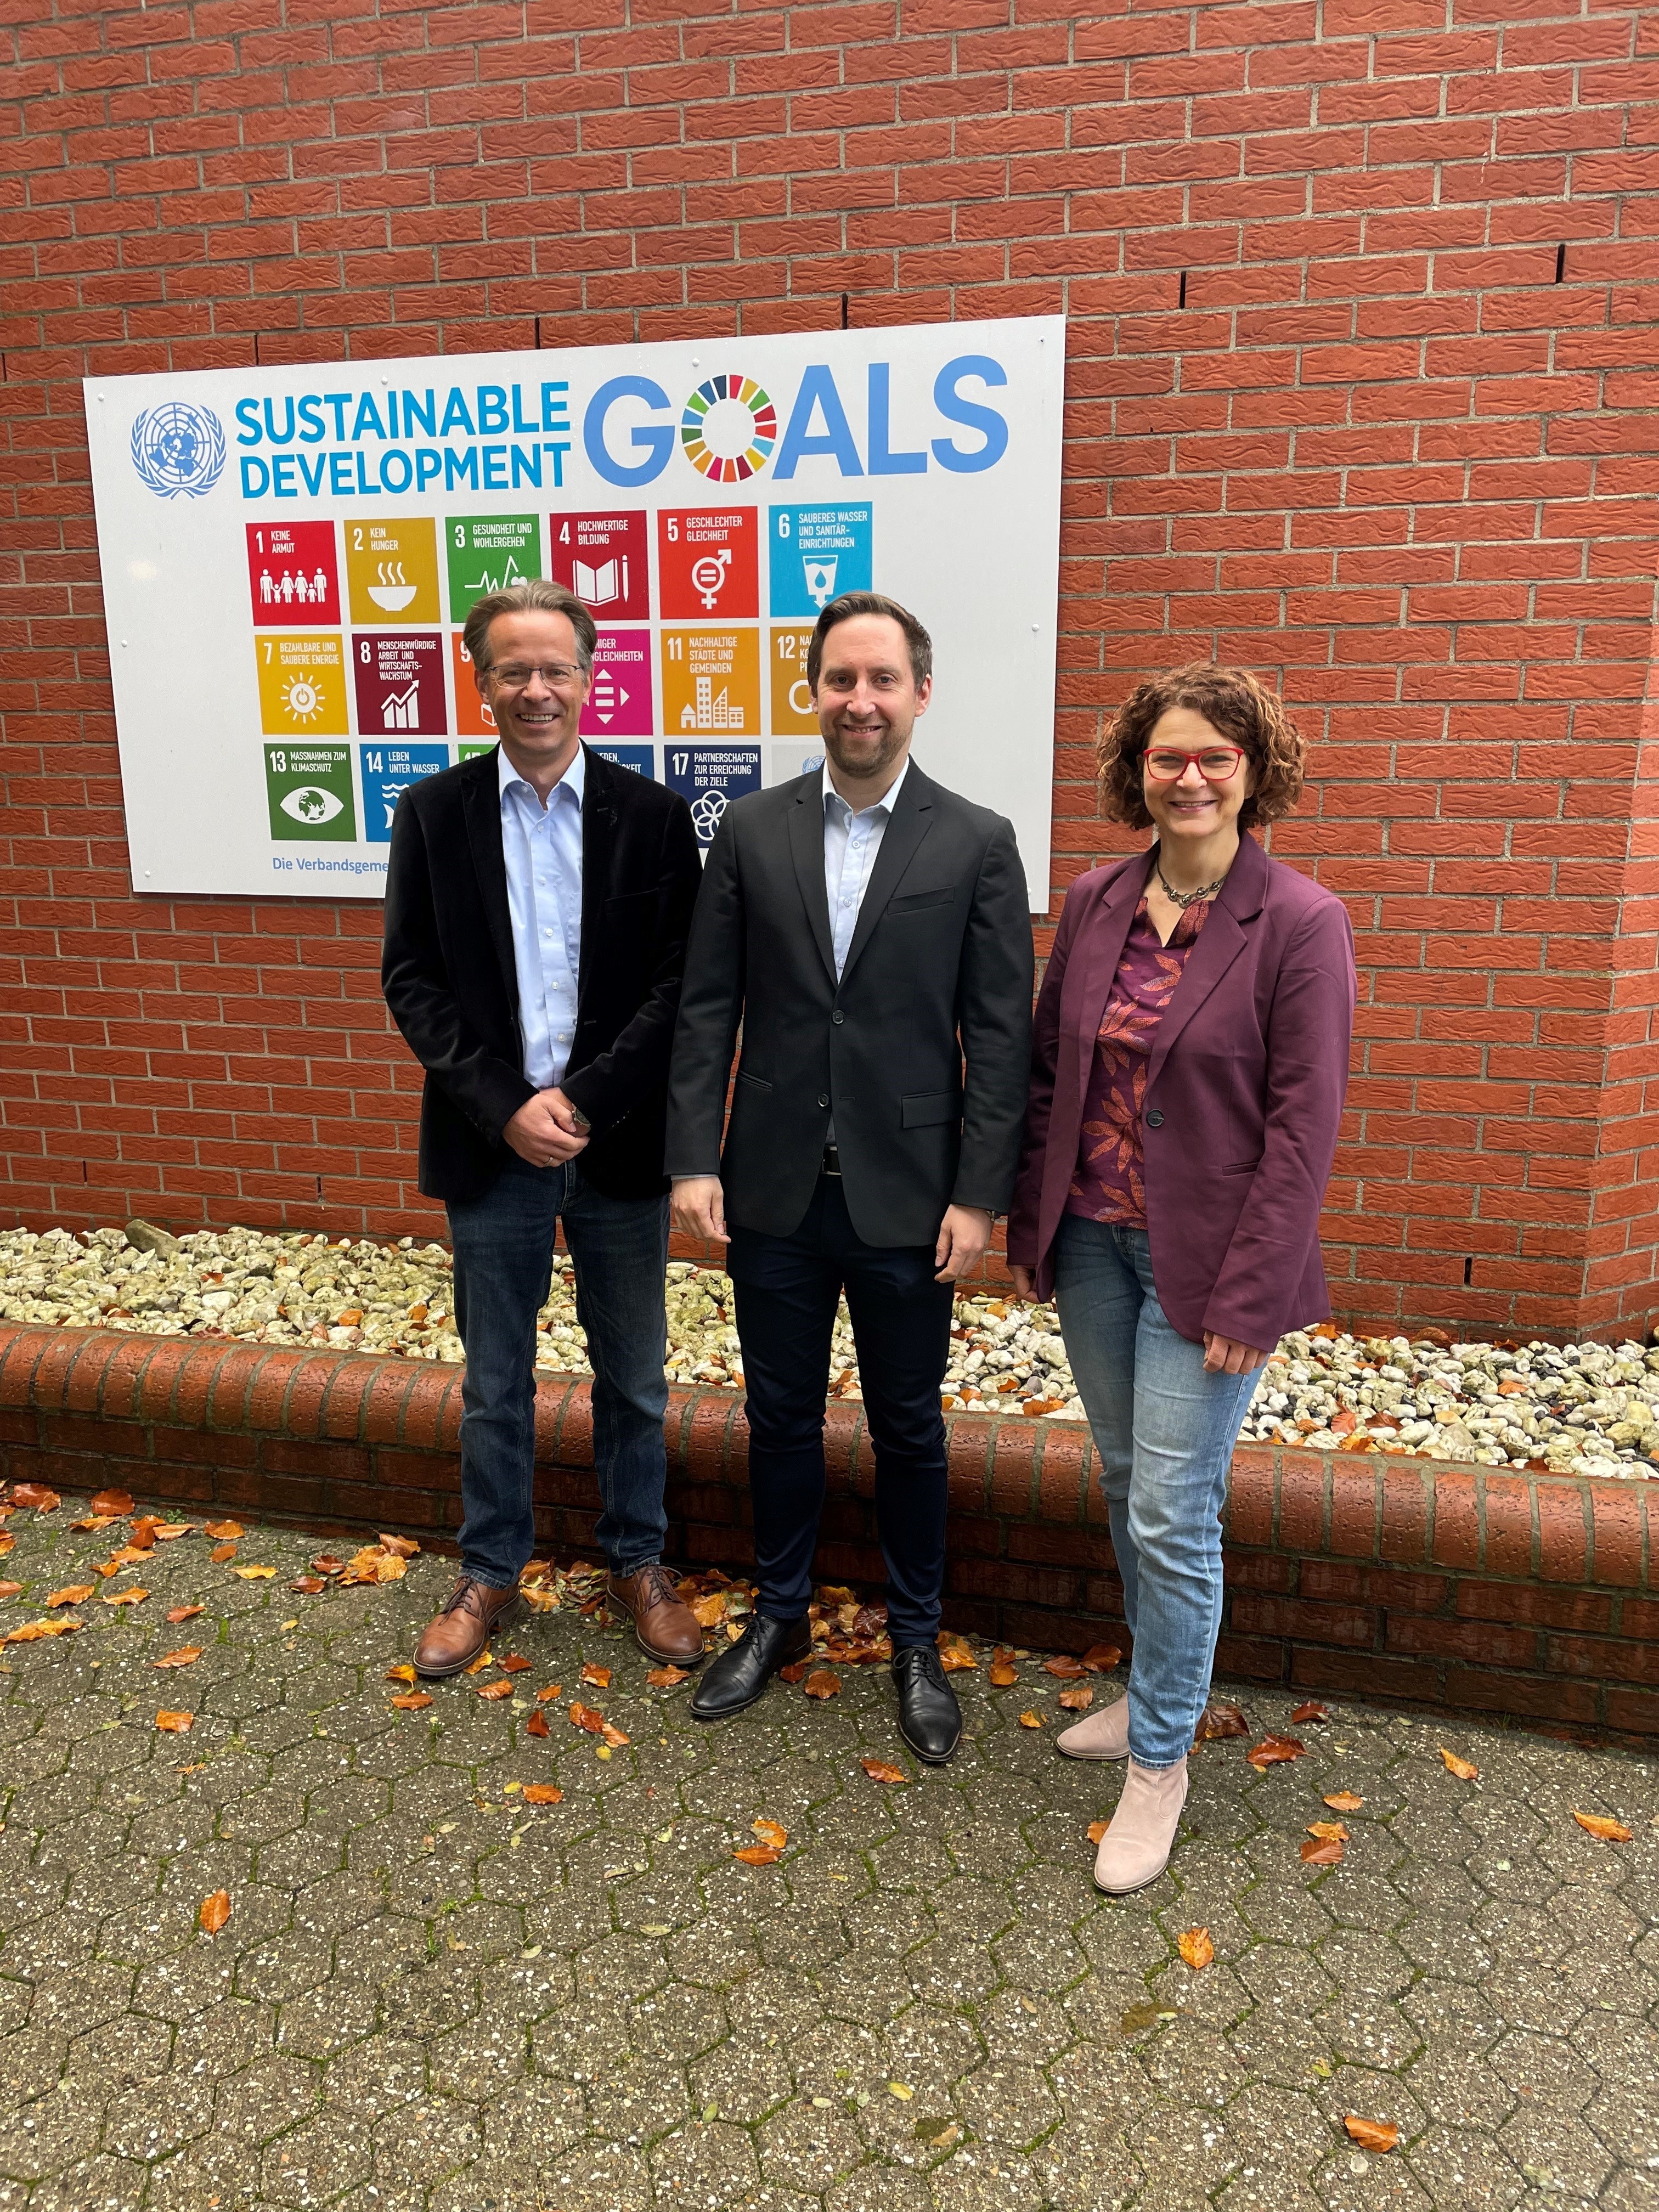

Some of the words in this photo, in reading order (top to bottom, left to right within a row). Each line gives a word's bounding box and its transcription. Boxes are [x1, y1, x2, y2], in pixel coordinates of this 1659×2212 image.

[235, 381, 570, 444] SUSTAINABLE
[584, 355, 1008, 487] GOALS
[240, 443, 571, 498] DEVELOPMENT
[686, 516, 742, 528] GESCHLECHTER
[798, 512, 836, 524] SAUBERES
[837, 511, 867, 522] WASSER
[472, 523, 515, 535] GESUNDHEIT
[517, 523, 532, 534] UND
[577, 520, 628, 532] HOCHWERTIGE
[667, 517, 679, 541] 5
[778, 514, 790, 538] 6
[799, 526, 814, 537] UND
[816, 523, 849, 535] SANITÄR-
[271, 530, 290, 541] KEINE
[353, 528, 363, 550] 2
[370, 528, 386, 538] KEIN
[455, 524, 465, 548] 3
[559, 521, 571, 545] 4
[578, 533, 610, 545] BILDUNG
[686, 530, 729, 542] GLEICHHEIT
[256, 531, 264, 553] 1
[371, 540, 398, 551] HUNGER
[473, 536, 525, 548] WOHLERGEHEN
[799, 538, 854, 549] EINRICHTUNGEN
[272, 543, 295, 554] ARMUT
[280, 642, 321, 653] BEZAHLBARE
[323, 642, 336, 652] UND
[377, 639, 436, 650] MENSCHENWÜRDIGE
[595, 638, 616, 648] NIGER
[689, 636, 737, 647] NACHHALTIGE
[777, 635, 795, 658] 12
[263, 642, 272, 664] 7
[360, 641, 371, 663] 8
[460, 641, 471, 662] 9
[667, 637, 682, 660] 11
[690, 648, 716, 661] STÄDTE
[718, 650, 733, 660] UND
[280, 654, 310, 664] SAUBERE
[312, 654, 340, 664] ENERGIE
[378, 651, 398, 660] ARBEIT
[402, 651, 414, 660] UND
[379, 661, 422, 670] WIRTSCHAFTS-
[690, 663, 732, 674] GEMEINDEN
[379, 671, 412, 680] WACHSTUM
[269, 751, 286, 772] 13
[290, 751, 332, 761] MASSNAHMEN
[334, 752, 347, 761] ZUM
[388, 752, 410, 761] LEBEN
[694, 753, 758, 763] PARTNERSCHAFTEN
[291, 763, 332, 772] KLIMASCHUTZ
[366, 752, 383, 774] 14
[389, 764, 411, 774] UNTER
[413, 764, 439, 774] WASSER
[672, 753, 689, 775] 17
[694, 765, 708, 774] ZUR
[709, 765, 752, 775] ERREICHUNG
[695, 777, 708, 786] DER
[709, 777, 728, 786] ZIELE
[273, 857, 292, 870] Die
[296, 857, 388, 874] Verbandsgeme
